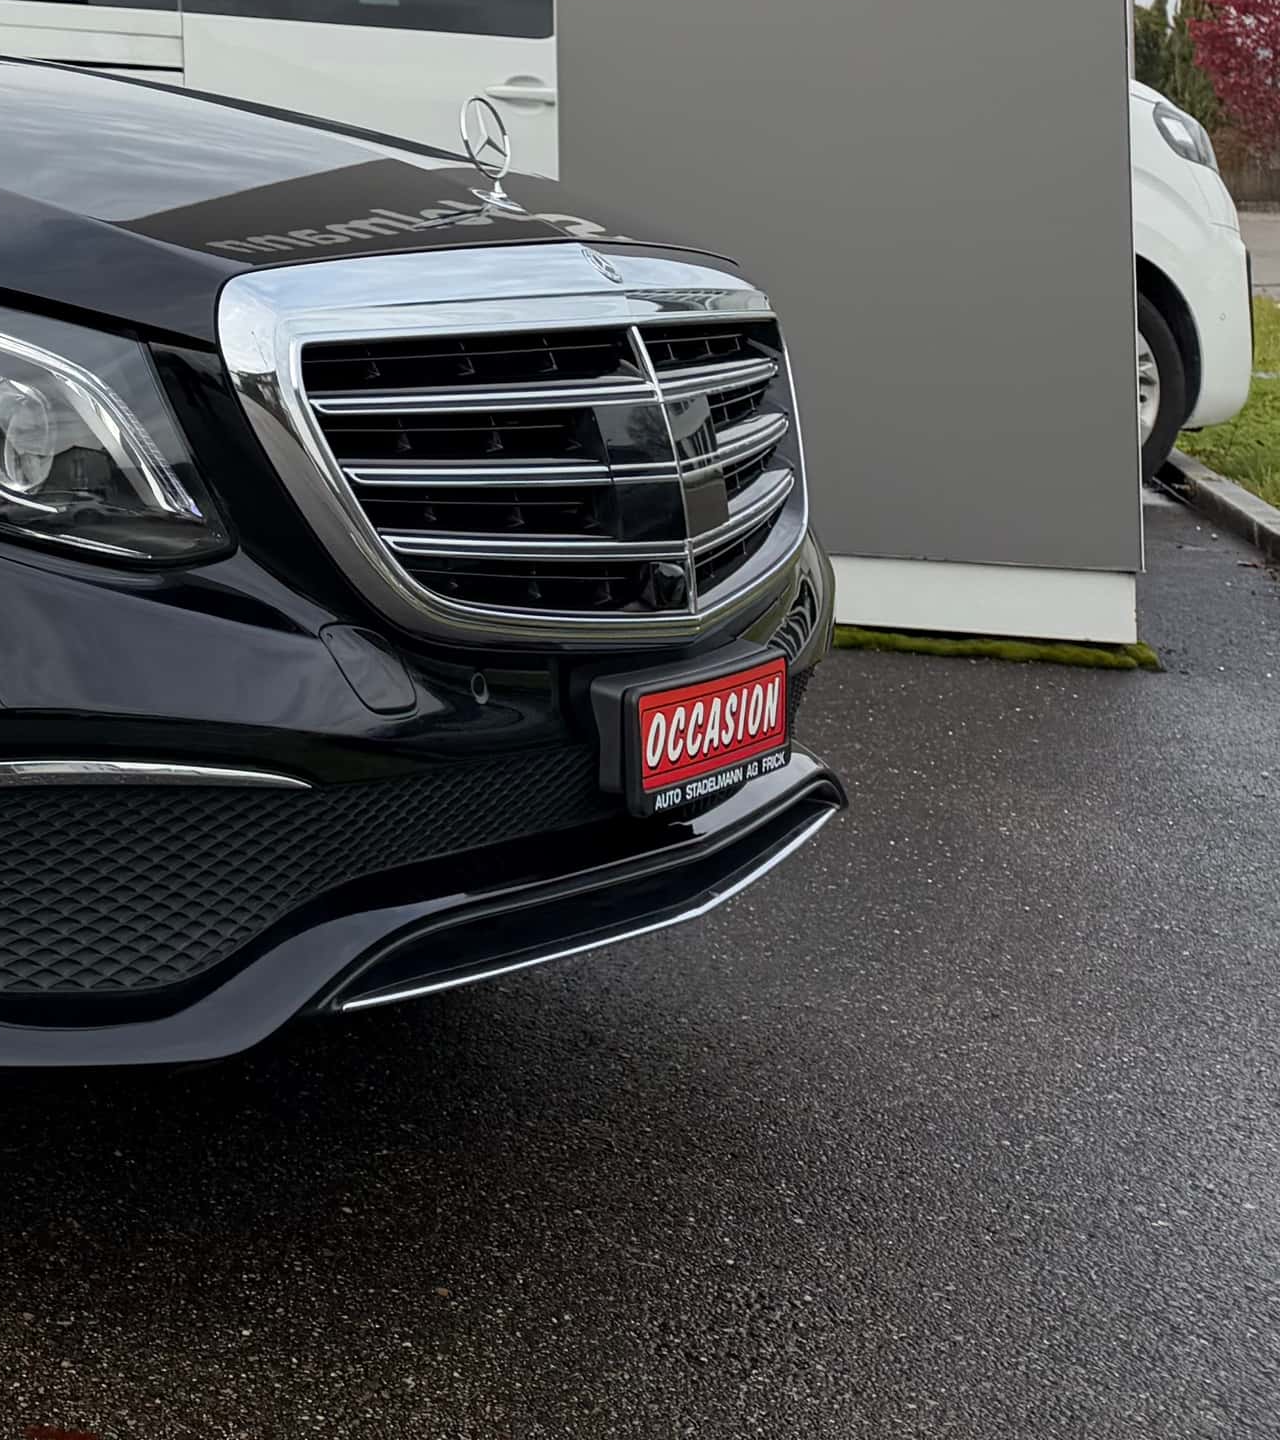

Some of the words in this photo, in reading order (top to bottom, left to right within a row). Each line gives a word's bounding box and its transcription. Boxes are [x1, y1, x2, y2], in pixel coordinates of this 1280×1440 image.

[646, 676, 780, 771] OCCASION
[655, 788, 682, 810] AUTO
[685, 768, 743, 800] STADELMANN
[746, 762, 758, 778] AG
[762, 751, 785, 773] FRICK
